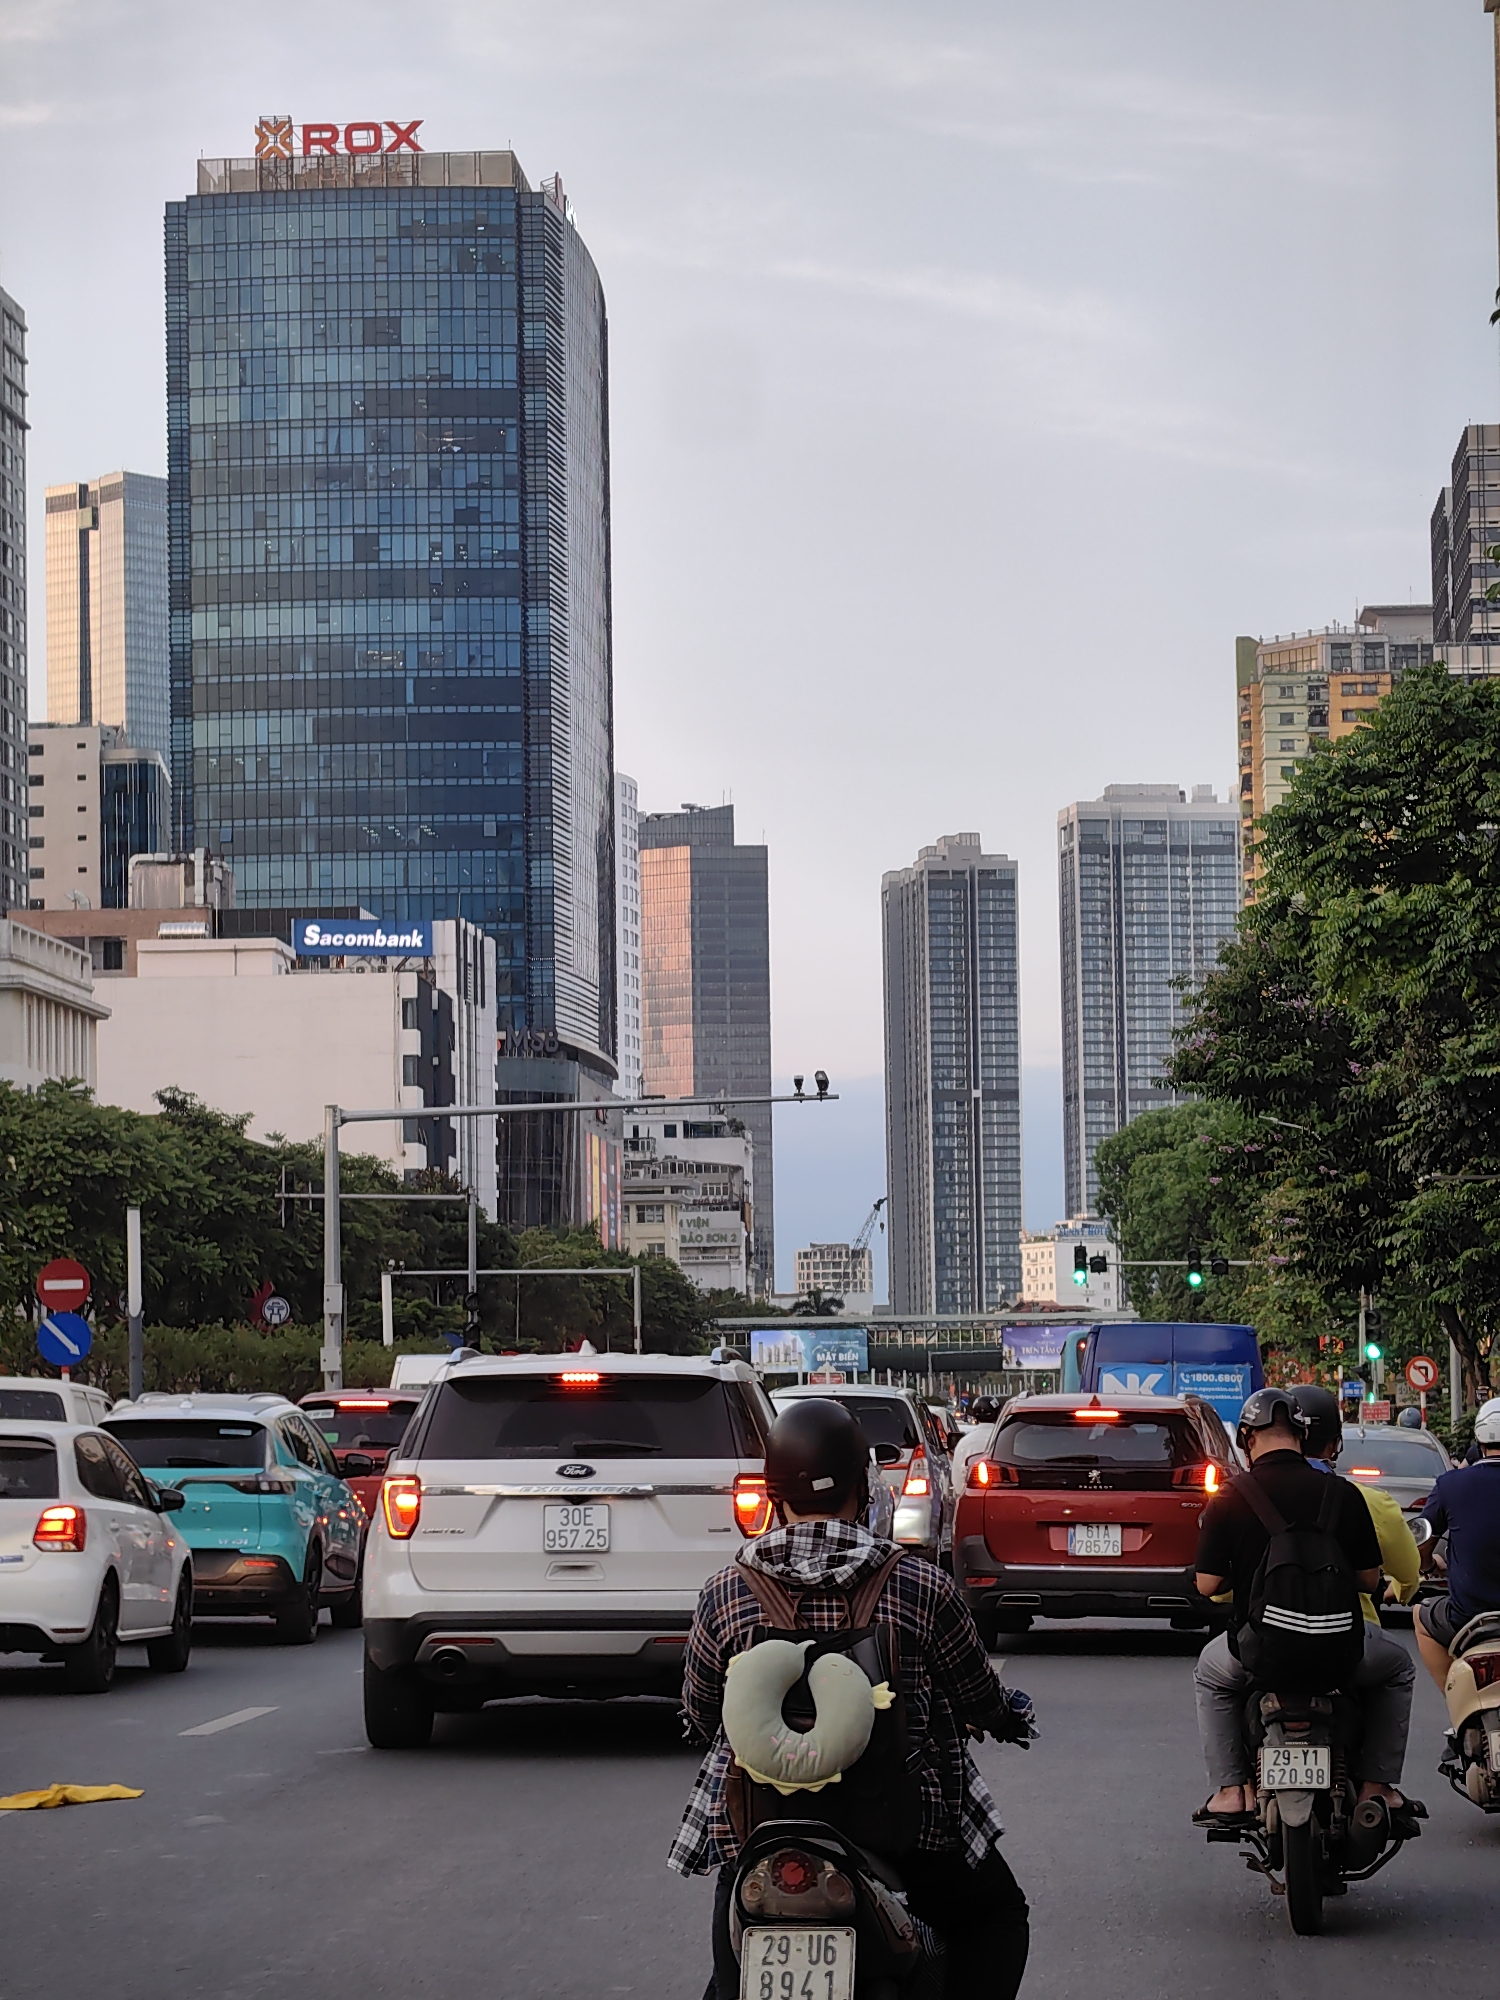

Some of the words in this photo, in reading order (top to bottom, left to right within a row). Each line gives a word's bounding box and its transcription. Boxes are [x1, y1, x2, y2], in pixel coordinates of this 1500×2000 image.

[302, 119, 425, 155] ROX
[303, 924, 424, 948] Sacombank
[505, 1024, 559, 1053] MSB
[686, 1215, 709, 1229] VIỆN
[680, 1231, 703, 1243] BẢO
[730, 1232, 737, 1243] 2
[1102, 1373, 1164, 1394] NK
[1190, 1373, 1243, 1382] 1800.6800
[563, 1465, 588, 1475] Ford
[559, 1507, 594, 1527] 30E
[546, 1528, 607, 1549] 957.25
[1086, 1525, 1111, 1539] 61A
[1076, 1540, 1120, 1554] 785.76
[1272, 1749, 1319, 1766] 29-Y1
[1266, 1768, 1325, 1786] 620.98
[761, 1934, 838, 1966] 29-U6
[759, 1970, 834, 2000] 8941
